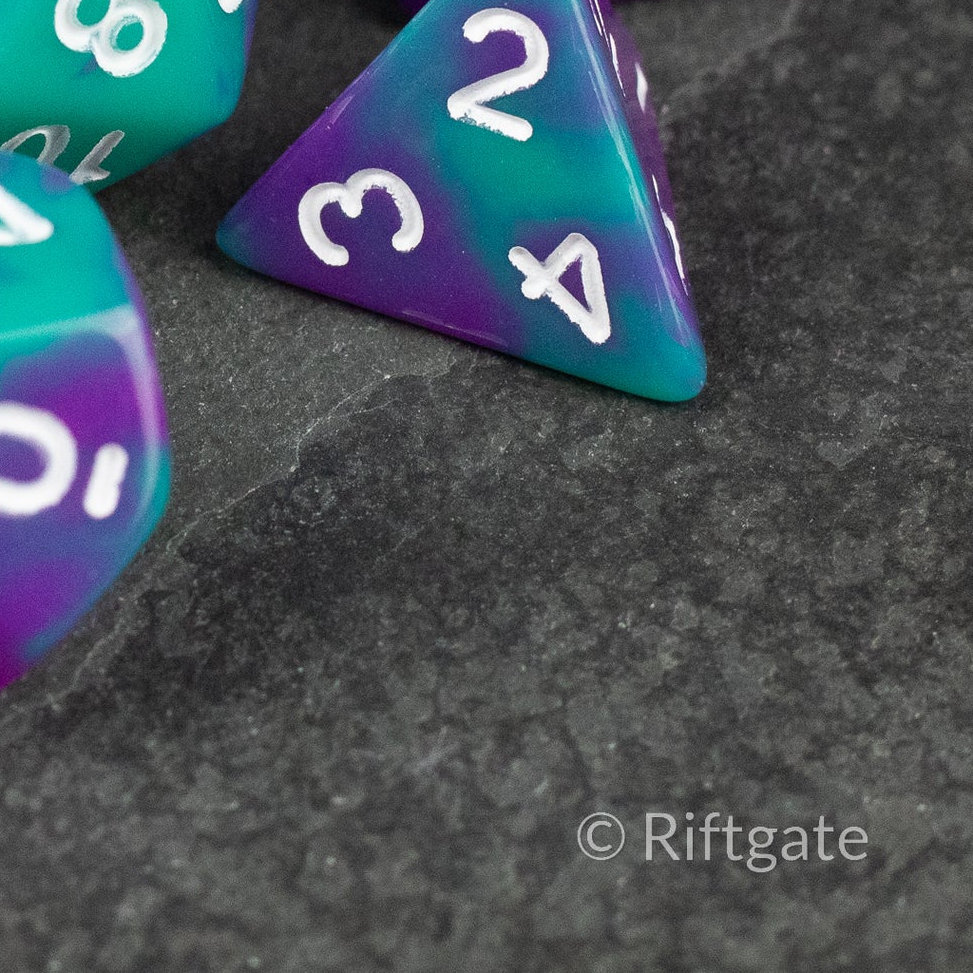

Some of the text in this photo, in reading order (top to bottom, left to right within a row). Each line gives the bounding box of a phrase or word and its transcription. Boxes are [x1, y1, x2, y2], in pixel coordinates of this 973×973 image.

[446, 7, 550, 142] 2
[297, 167, 425, 267] 3
[507, 232, 612, 345] 4
